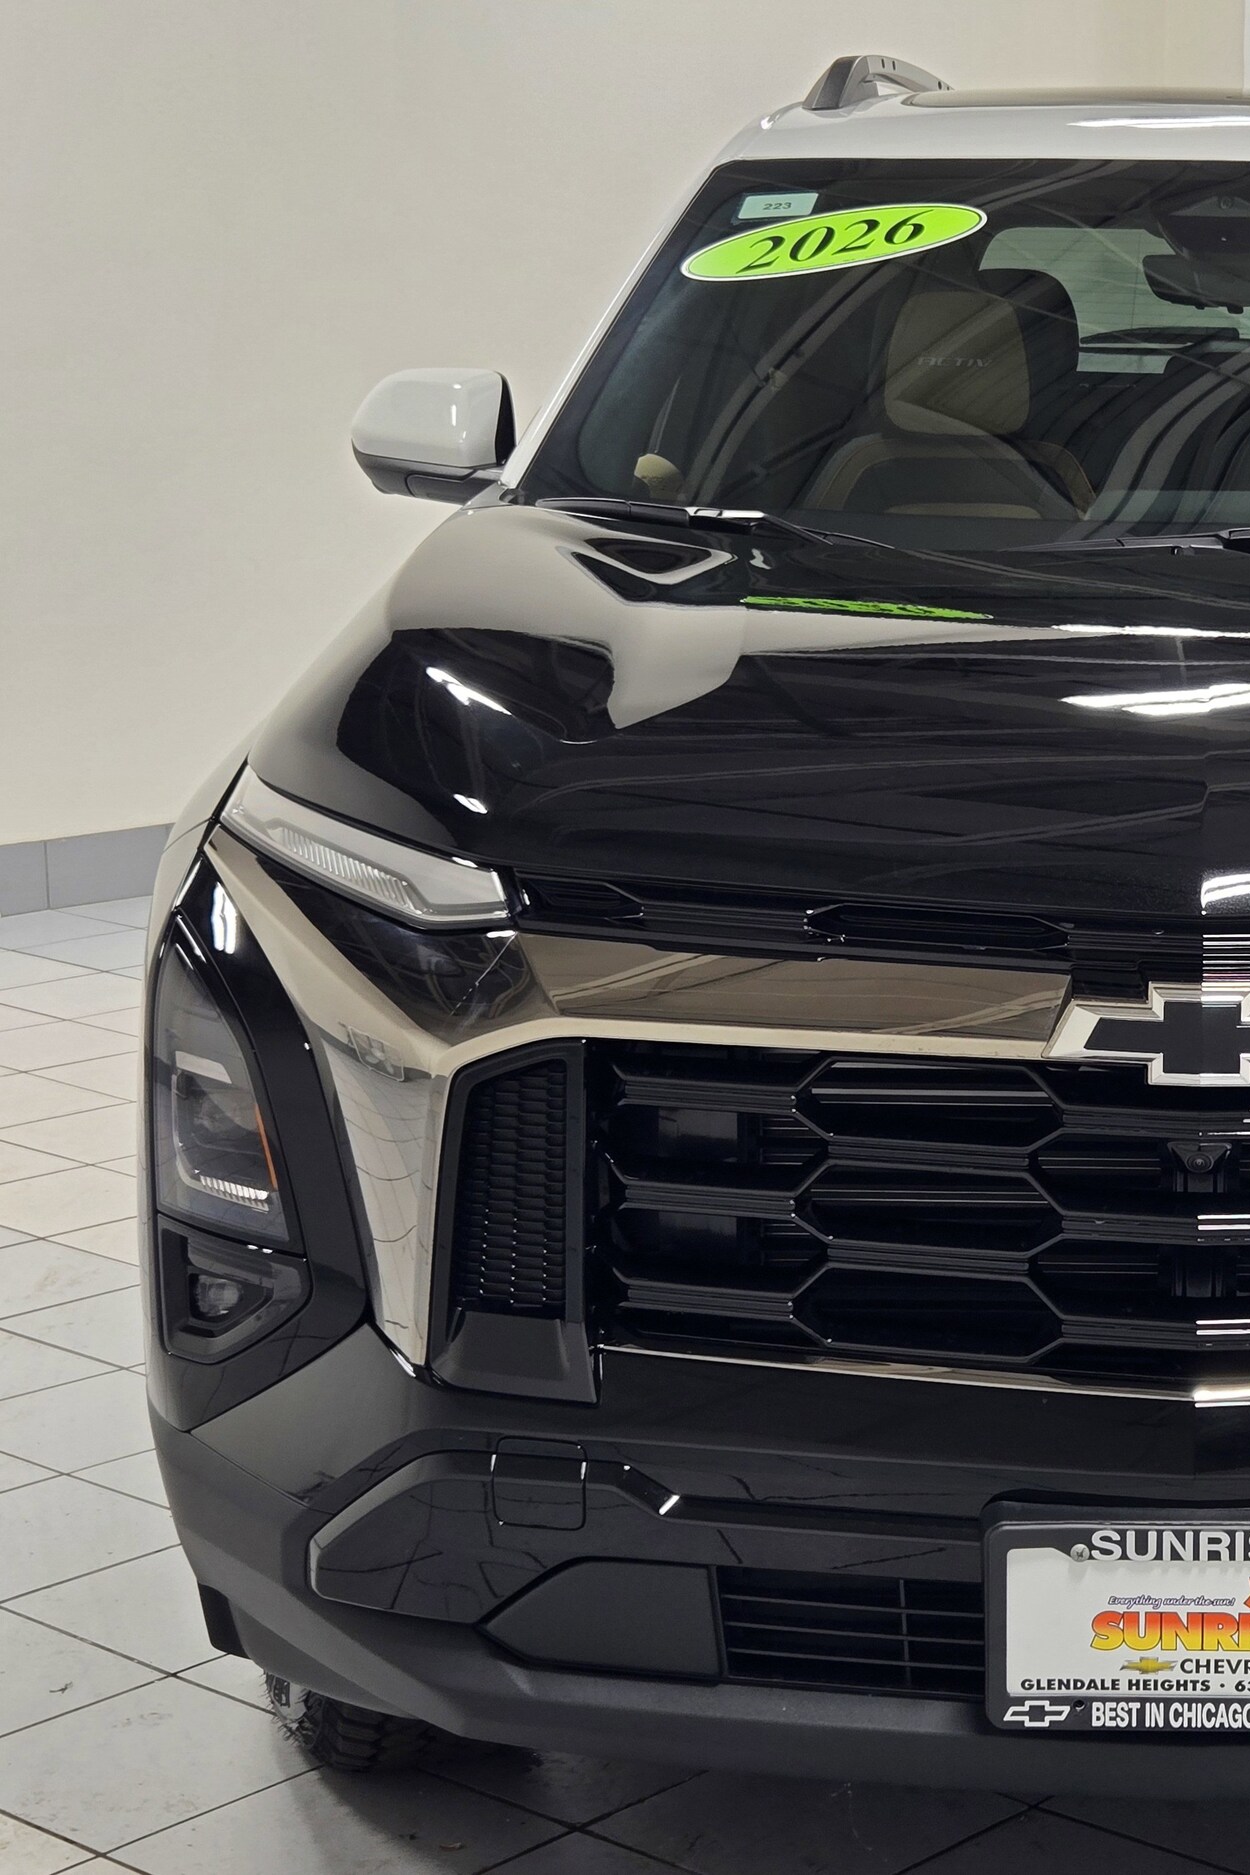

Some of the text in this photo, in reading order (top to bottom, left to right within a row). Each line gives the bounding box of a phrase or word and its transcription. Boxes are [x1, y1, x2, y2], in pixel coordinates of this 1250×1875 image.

[762, 201, 792, 211] 223
[735, 208, 934, 274] 2026
[917, 356, 993, 368] ACTIV
[1108, 1595, 1162, 1610] Everything
[1163, 1595, 1195, 1607] under
[1194, 1595, 1212, 1607] the
[1020, 1678, 1121, 1692] GLENDALE
[1127, 1679, 1211, 1692] HEIGHTS
[1091, 1701, 1142, 1729] BEST
[1145, 1702, 1165, 1729] IN
